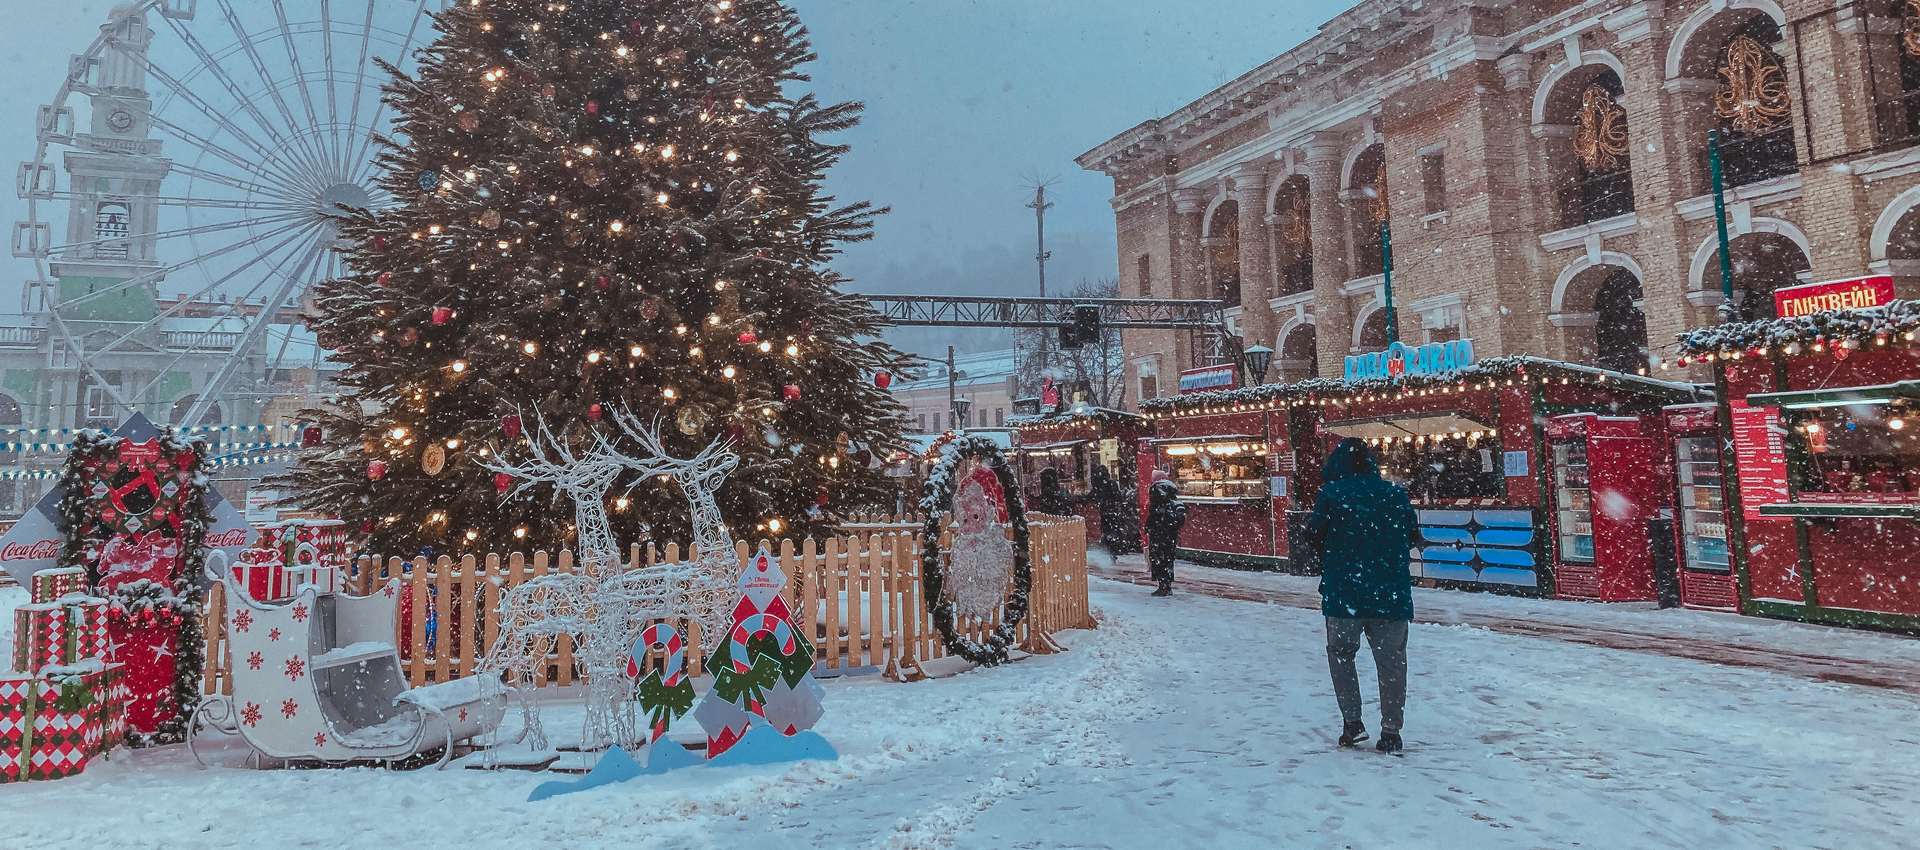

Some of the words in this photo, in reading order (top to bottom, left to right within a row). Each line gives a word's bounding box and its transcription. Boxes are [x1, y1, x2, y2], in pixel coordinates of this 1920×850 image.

[1782, 285, 1877, 317] ГЛІНТВЕЙН
[1405, 339, 1474, 375] КАКАО
[1, 539, 60, 561] Coca-Cola
[201, 528, 247, 548] oca-Cola
